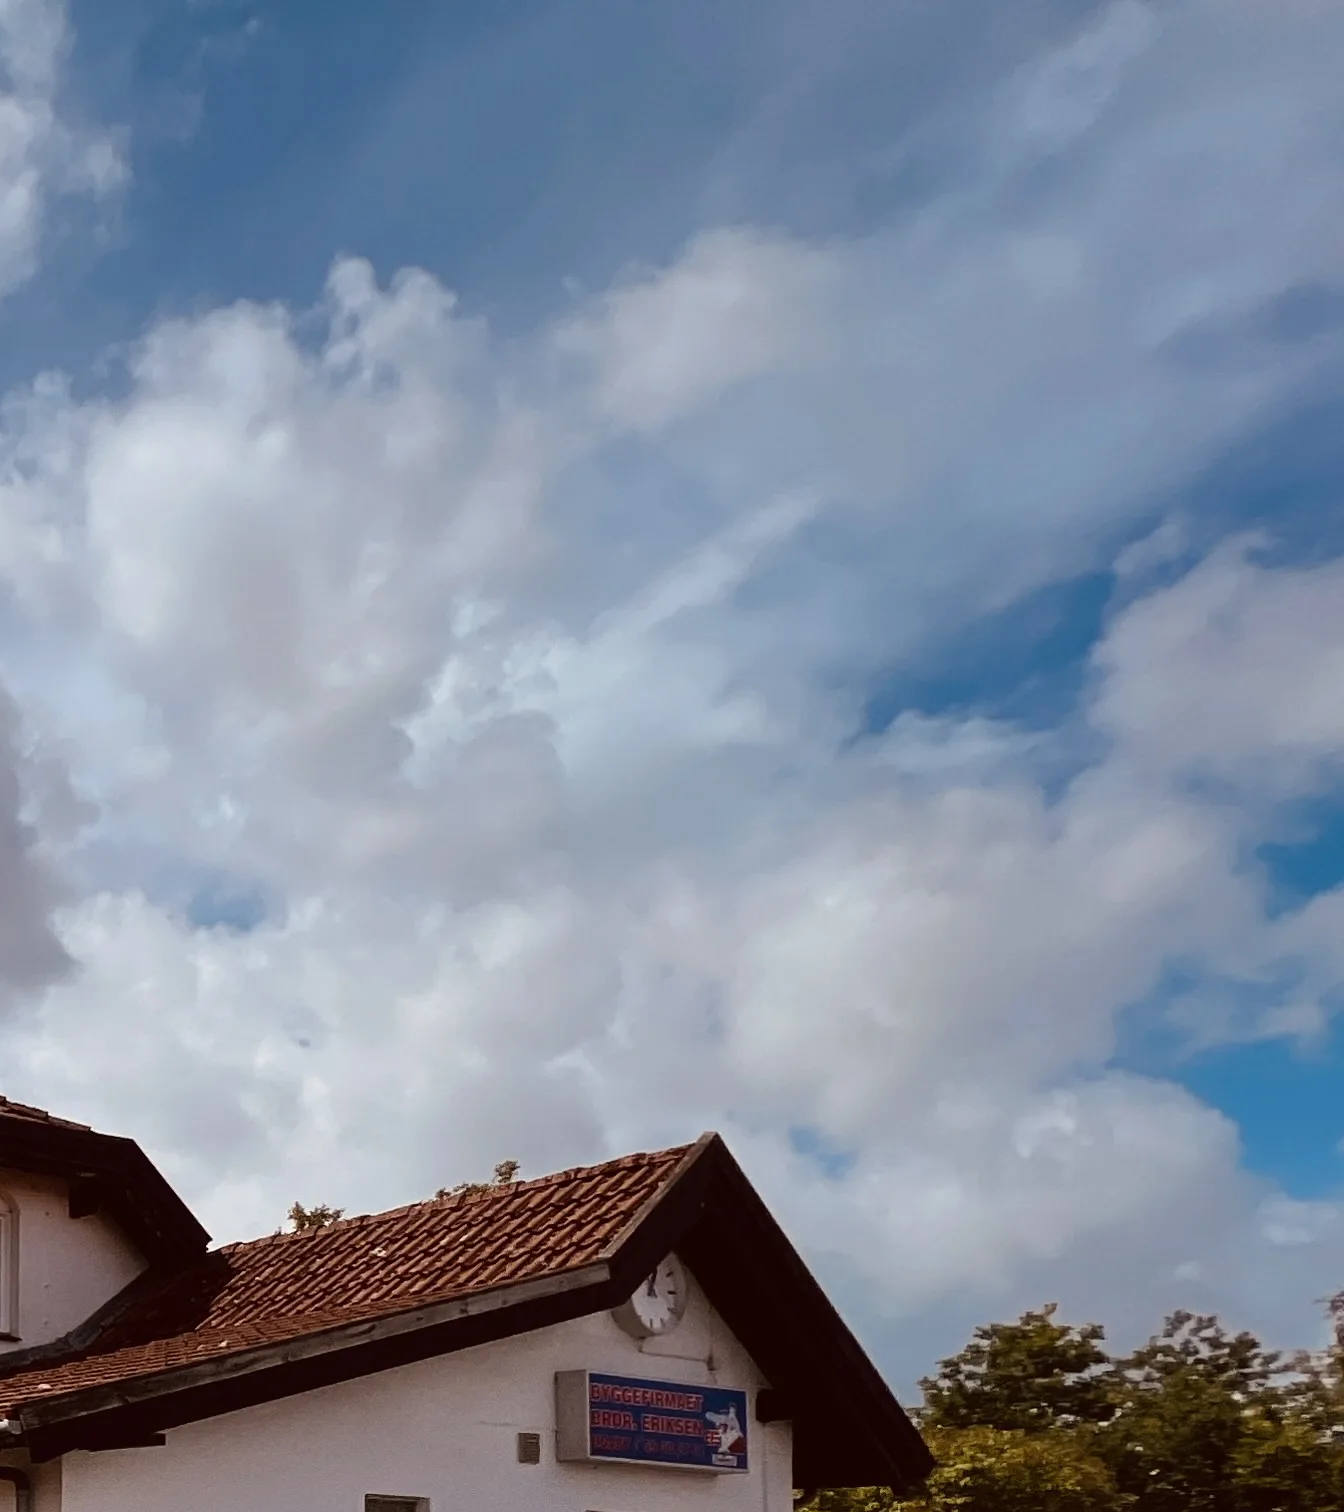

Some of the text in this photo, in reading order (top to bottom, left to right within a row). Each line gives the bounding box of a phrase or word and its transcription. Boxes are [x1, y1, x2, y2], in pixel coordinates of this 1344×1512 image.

[590, 1383, 703, 1412] BYGGEFIRMAET
[590, 1409, 704, 1437] BRDR. ERIKSEN
